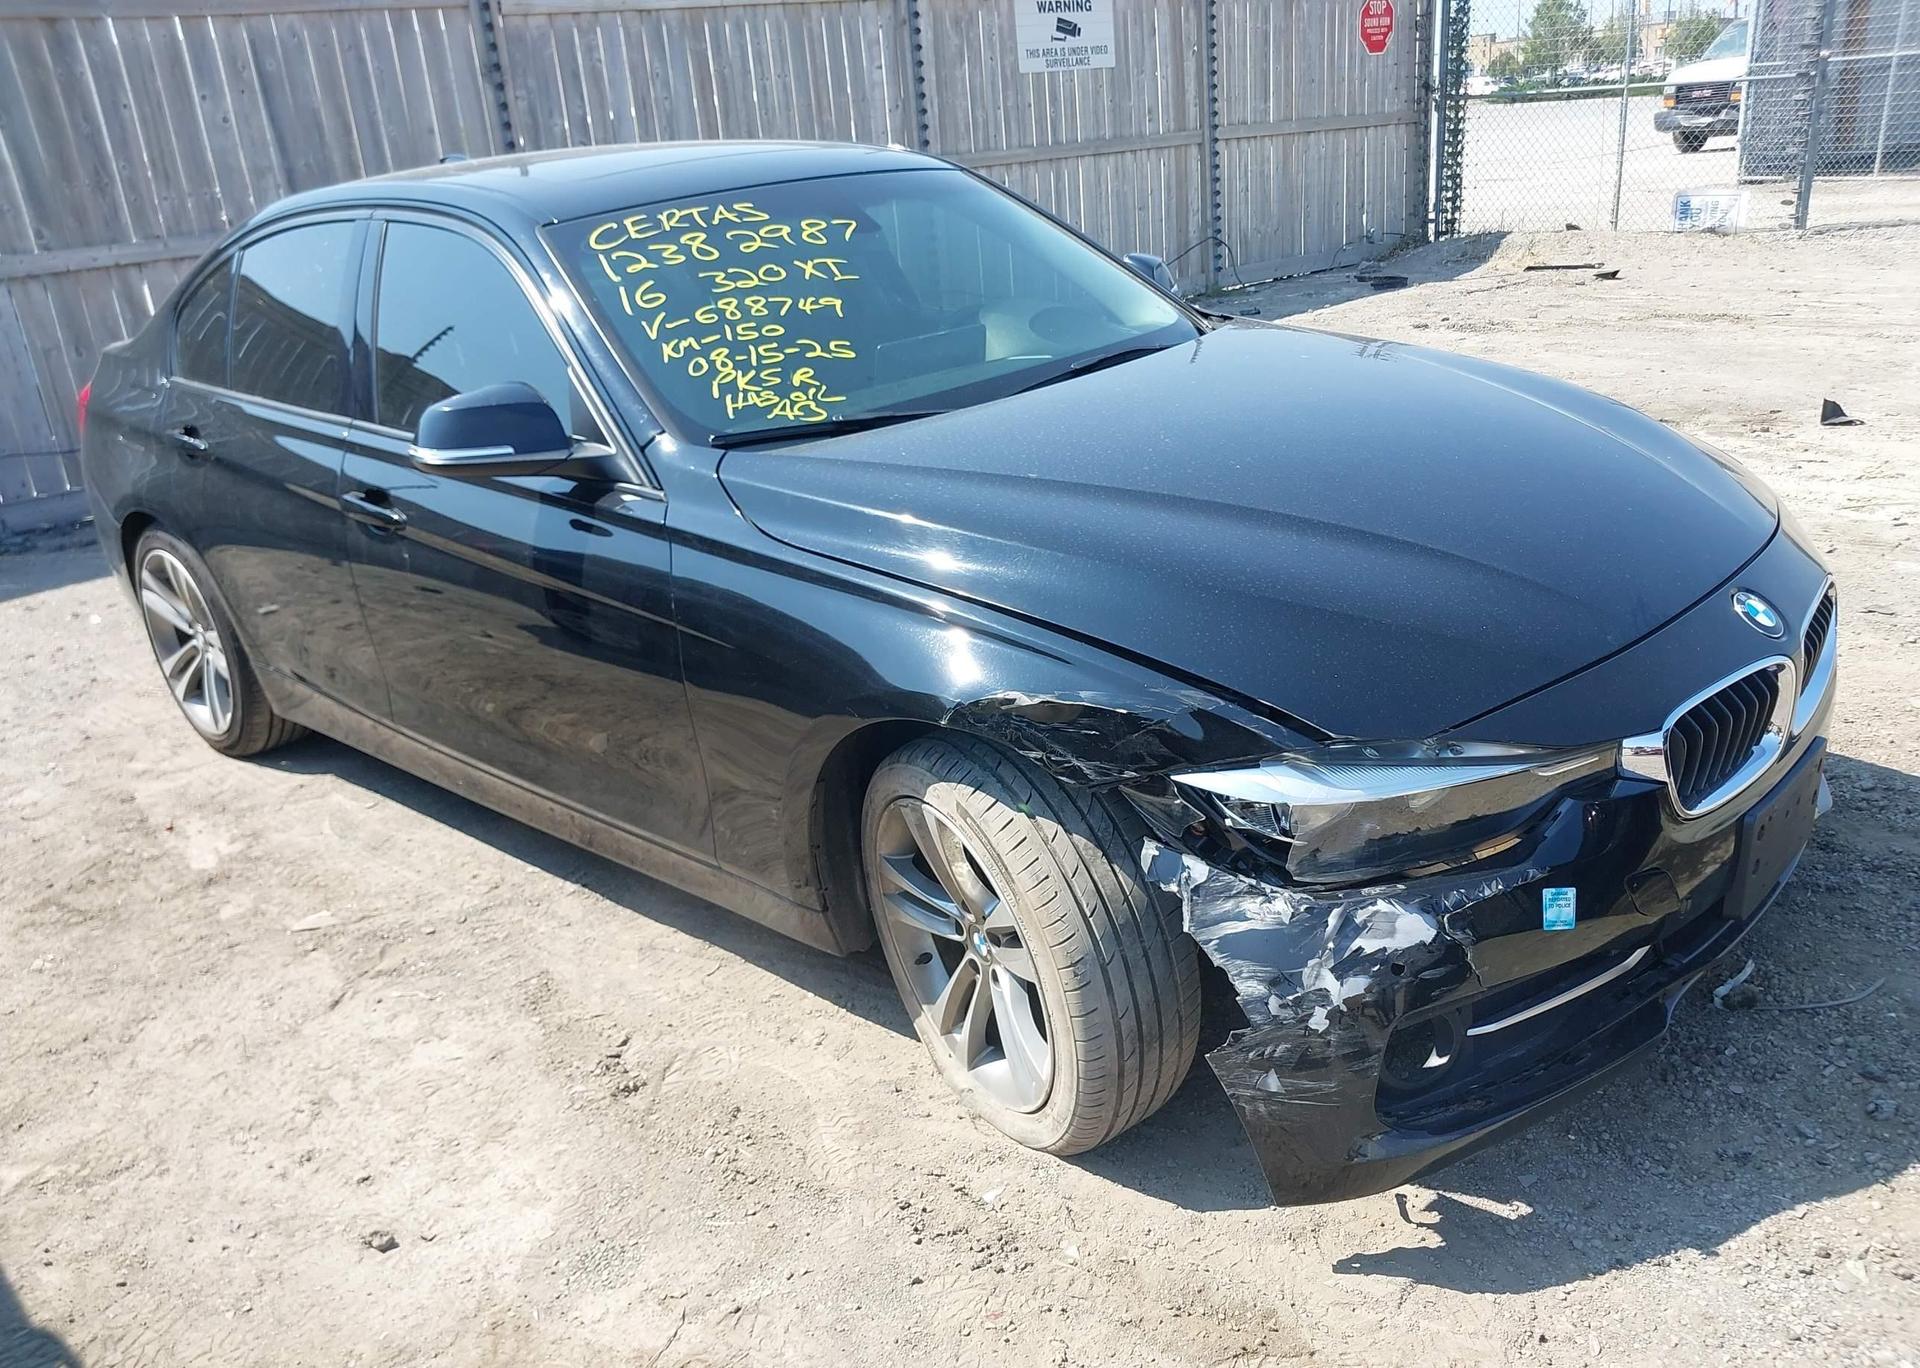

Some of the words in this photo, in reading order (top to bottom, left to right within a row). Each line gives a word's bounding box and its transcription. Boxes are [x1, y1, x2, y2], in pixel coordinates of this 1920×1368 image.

[1037, 0, 1092, 14] WARNING
[1369, 0, 1387, 15] STOP
[1026, 49, 1040, 59] THIS
[1042, 48, 1059, 58] AREA
[1060, 48, 1066, 57] IS
[1067, 46, 1089, 57] UNDER
[1090, 45, 1108, 55] VIDEO
[1045, 57, 1091, 68] SURVEILLANCE
[588, 202, 771, 251] CERTAS
[618, 280, 668, 316] 16
[698, 264, 788, 293] 320
[793, 258, 861, 281] XI
[640, 296, 845, 341] V-688749
[688, 339, 857, 378] 08-15-25
